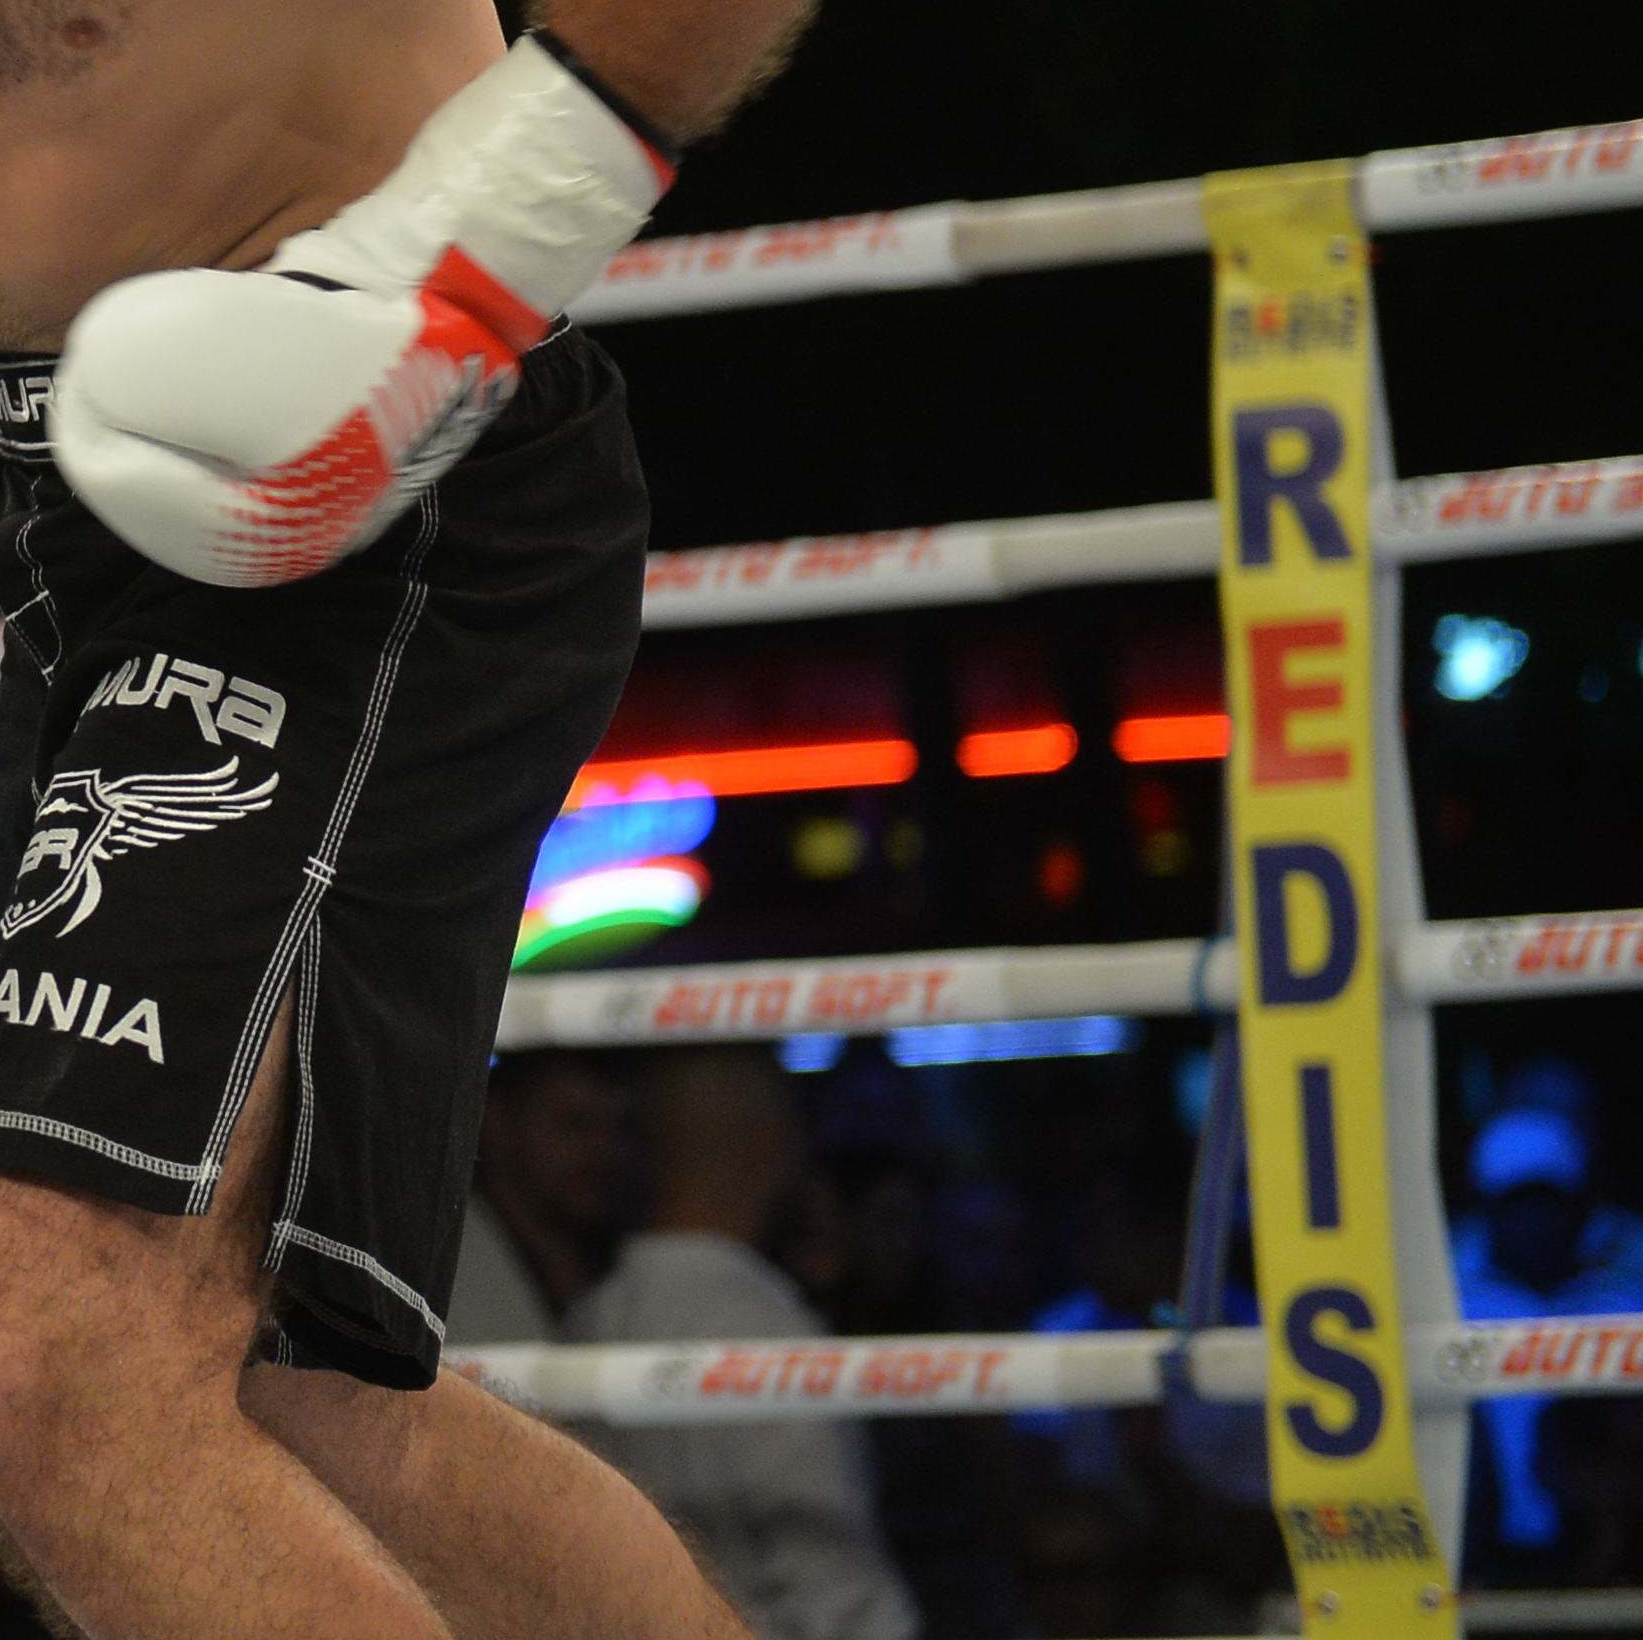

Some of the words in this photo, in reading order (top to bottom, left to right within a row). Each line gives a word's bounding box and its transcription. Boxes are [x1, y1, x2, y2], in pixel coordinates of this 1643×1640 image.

[1232, 402, 1385, 1458] REDIS
[1516, 918, 1643, 977] AUT
[654, 974, 795, 1031] AUTO
[699, 1348, 846, 1400] AUTO
